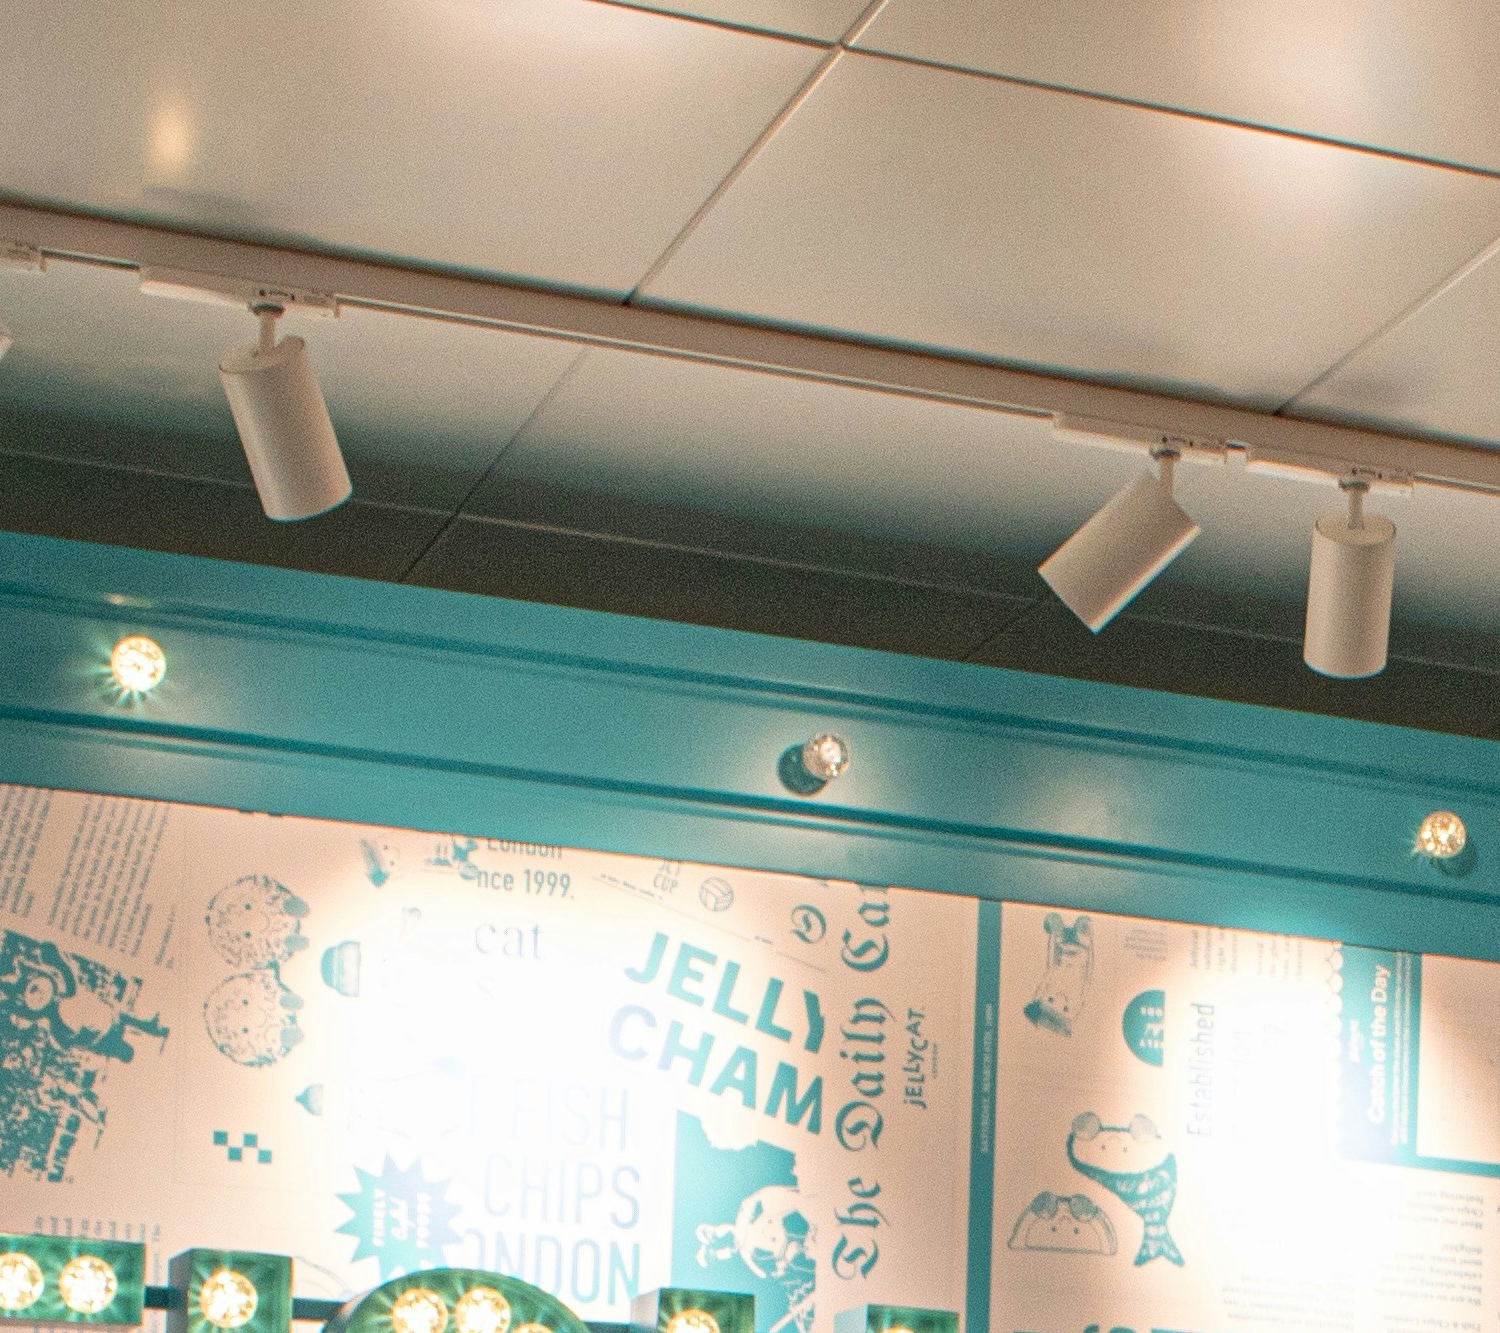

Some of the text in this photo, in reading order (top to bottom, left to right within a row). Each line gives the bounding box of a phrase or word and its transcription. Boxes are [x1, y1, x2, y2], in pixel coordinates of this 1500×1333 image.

[523, 871, 576, 900] 1999.
[1186, 1001, 1217, 1139] Established
[1366, 963, 1393, 1123] Catch of the Day
[484, 1152, 642, 1231] CHIPS
[830, 994, 897, 1281] The Daily
